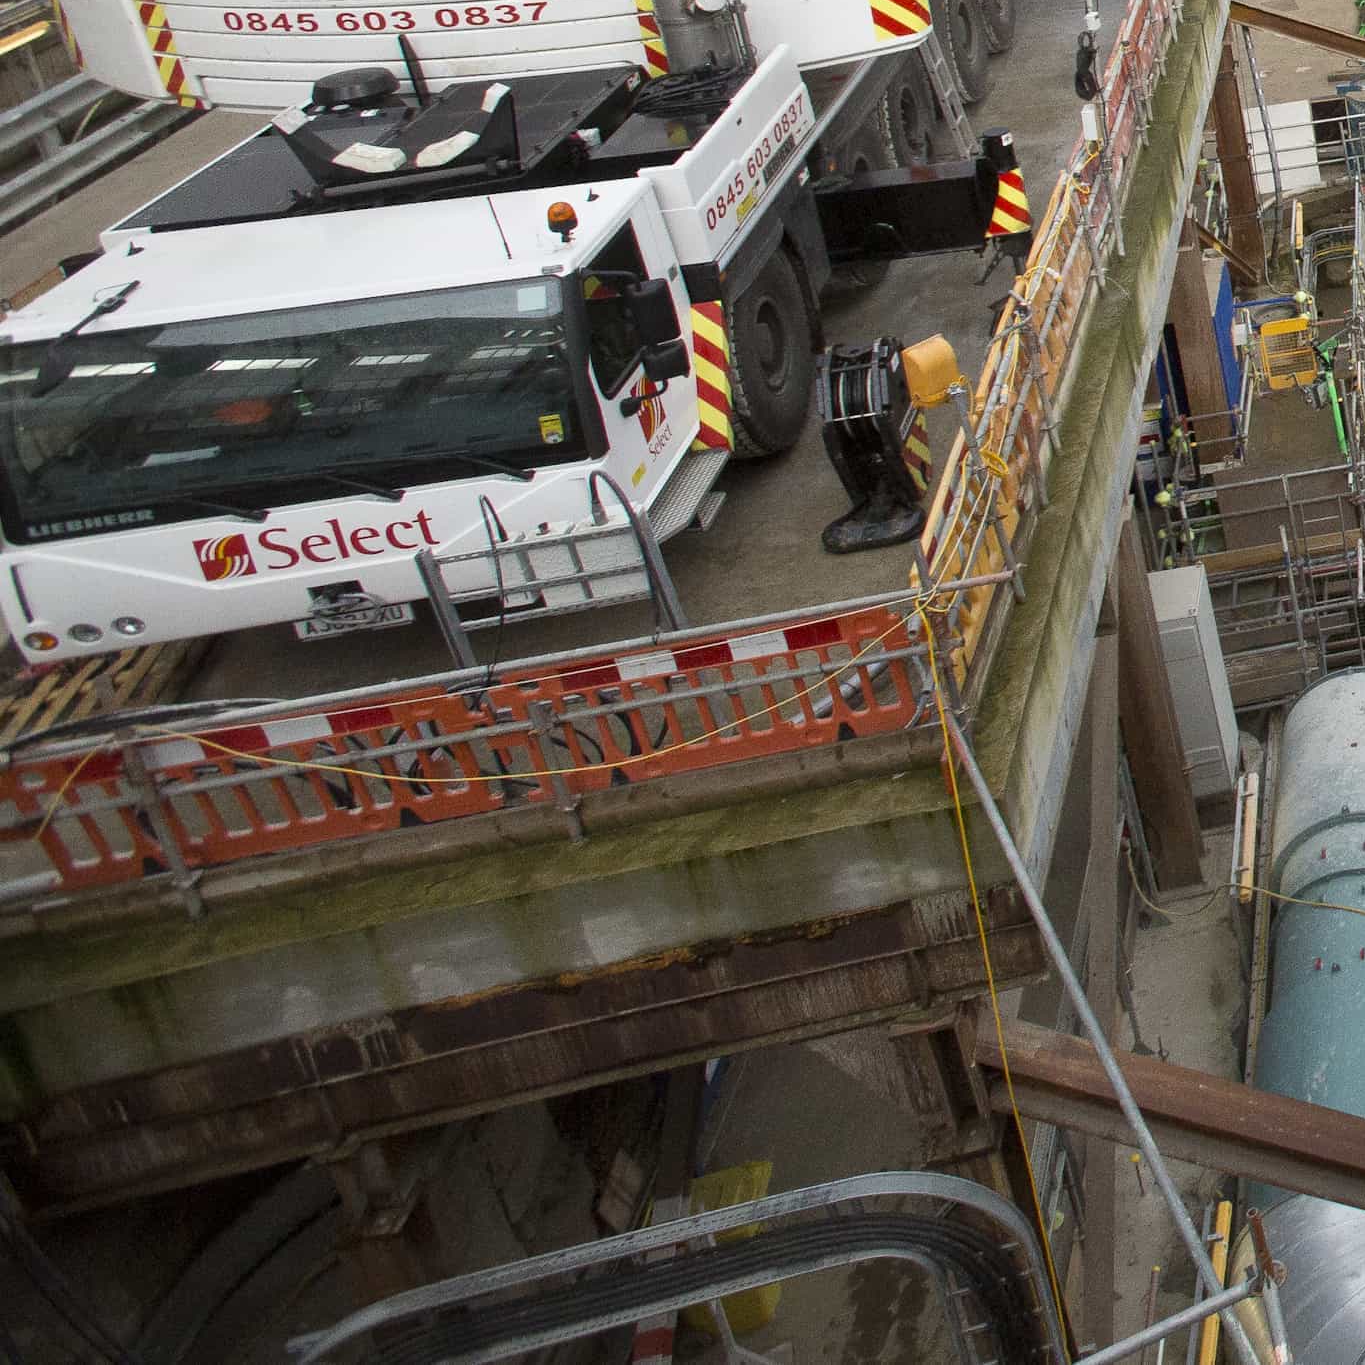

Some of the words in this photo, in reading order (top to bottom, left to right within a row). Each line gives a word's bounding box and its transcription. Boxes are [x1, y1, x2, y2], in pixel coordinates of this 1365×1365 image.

[223, 11, 320, 33] 0845
[335, 10, 417, 32] 603
[433, 1, 549, 28] 0837
[705, 172, 745, 232] 0845
[746, 137, 772, 179] 603
[773, 93, 804, 143] 0837
[648, 422, 673, 463] Select
[27, 507, 155, 538] LIEBHERR
[257, 508, 441, 570] Select
